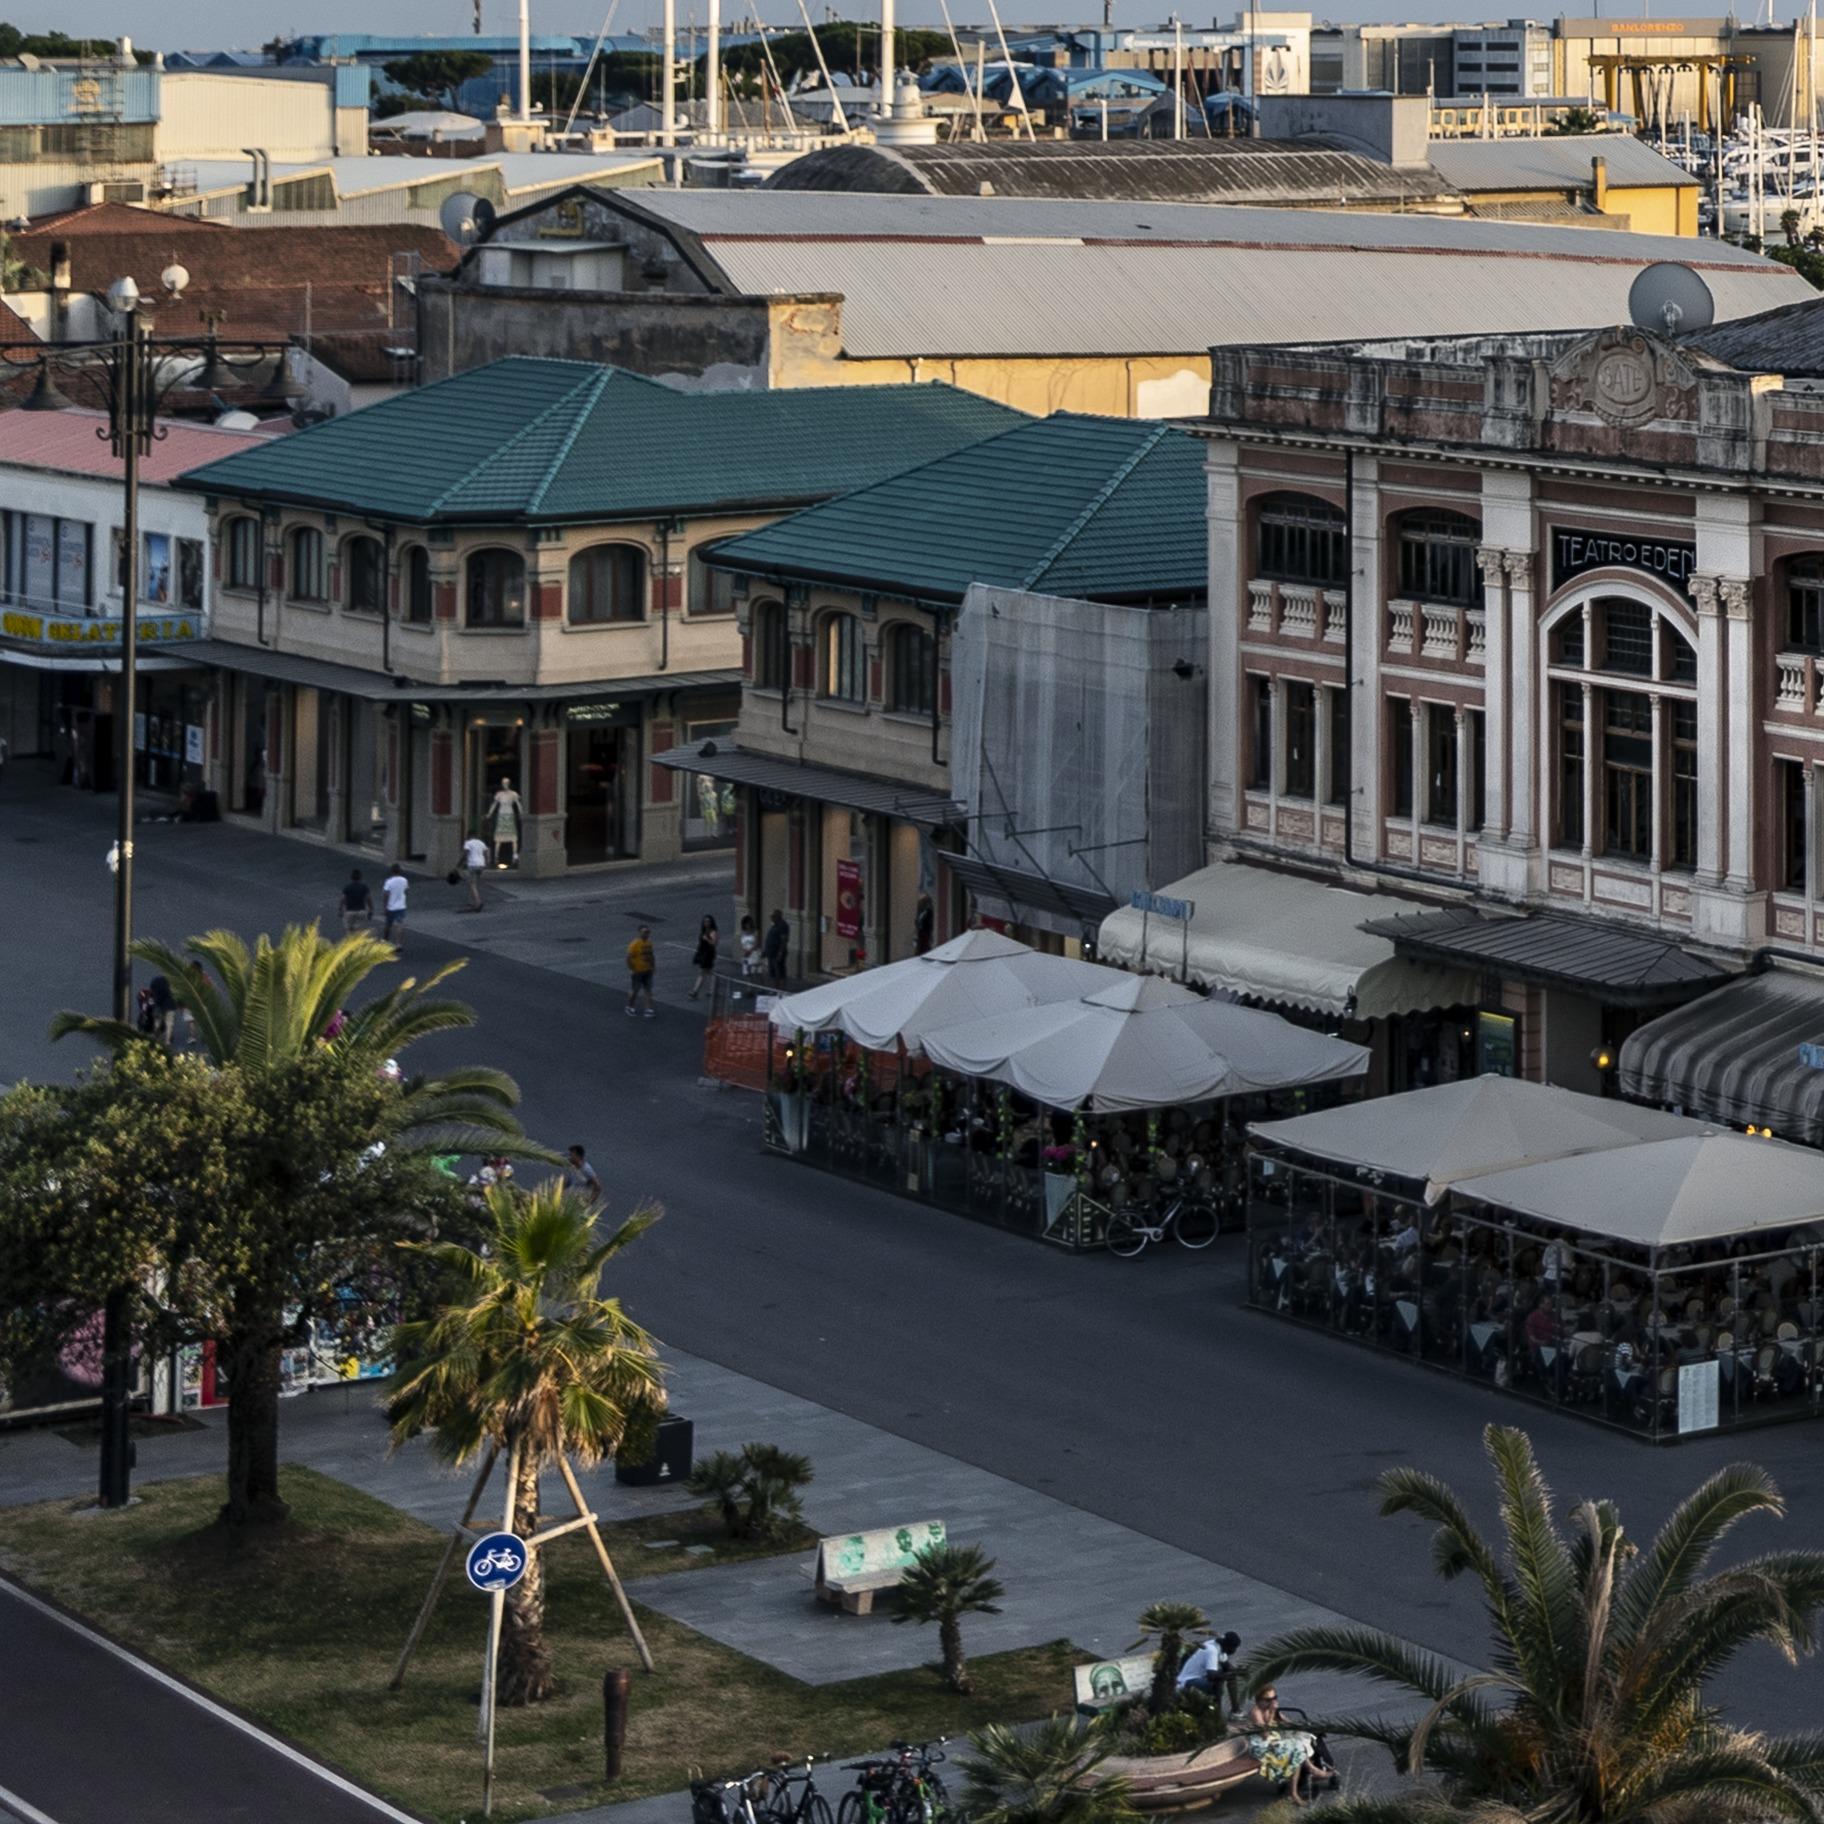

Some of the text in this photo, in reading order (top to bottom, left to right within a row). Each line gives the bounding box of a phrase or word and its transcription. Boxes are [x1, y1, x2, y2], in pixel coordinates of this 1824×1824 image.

[1558, 535, 1697, 579] TEATRO EDEN
[48, 621, 192, 641] GELATRIA
